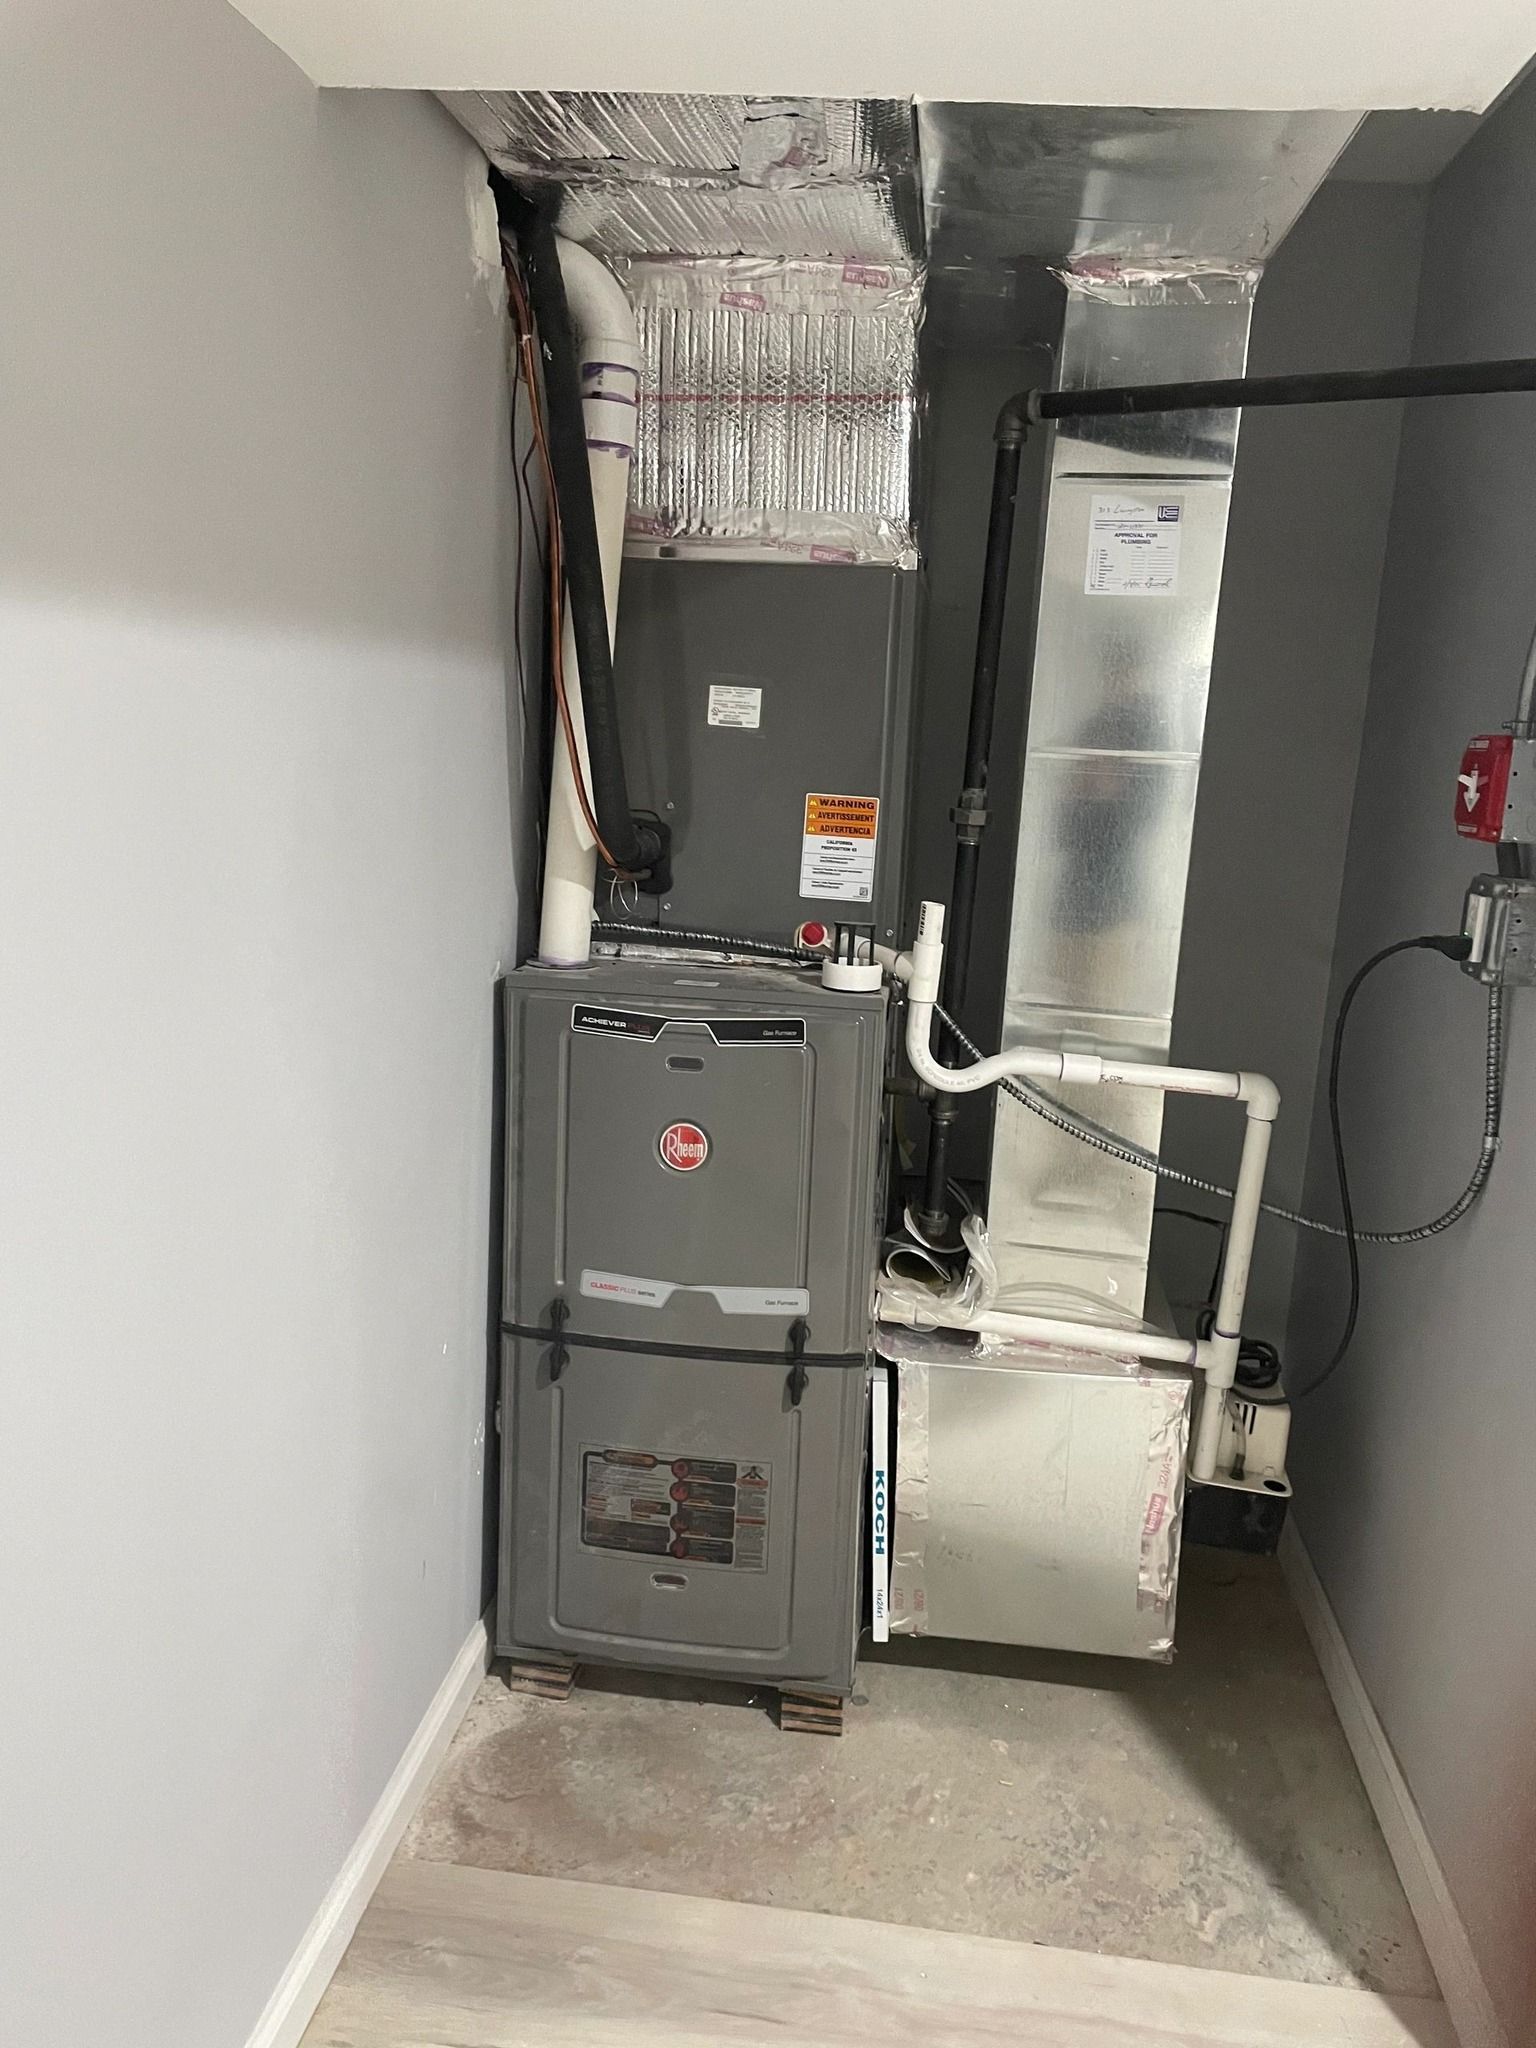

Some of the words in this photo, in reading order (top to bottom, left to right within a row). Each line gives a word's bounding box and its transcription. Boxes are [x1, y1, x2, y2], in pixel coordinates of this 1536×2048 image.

[819, 798, 875, 809] WARNING
[818, 811, 874, 822] AVERTISSEMENT
[820, 824, 871, 835] ADVERTENCIA
[581, 1015, 627, 1029] ACHIEVER
[666, 1127, 704, 1163] Rheem
[590, 1281, 619, 1292] CLASSIC
[875, 1470, 885, 1554] KOCH
[876, 1588, 884, 1619] 14x24x1
